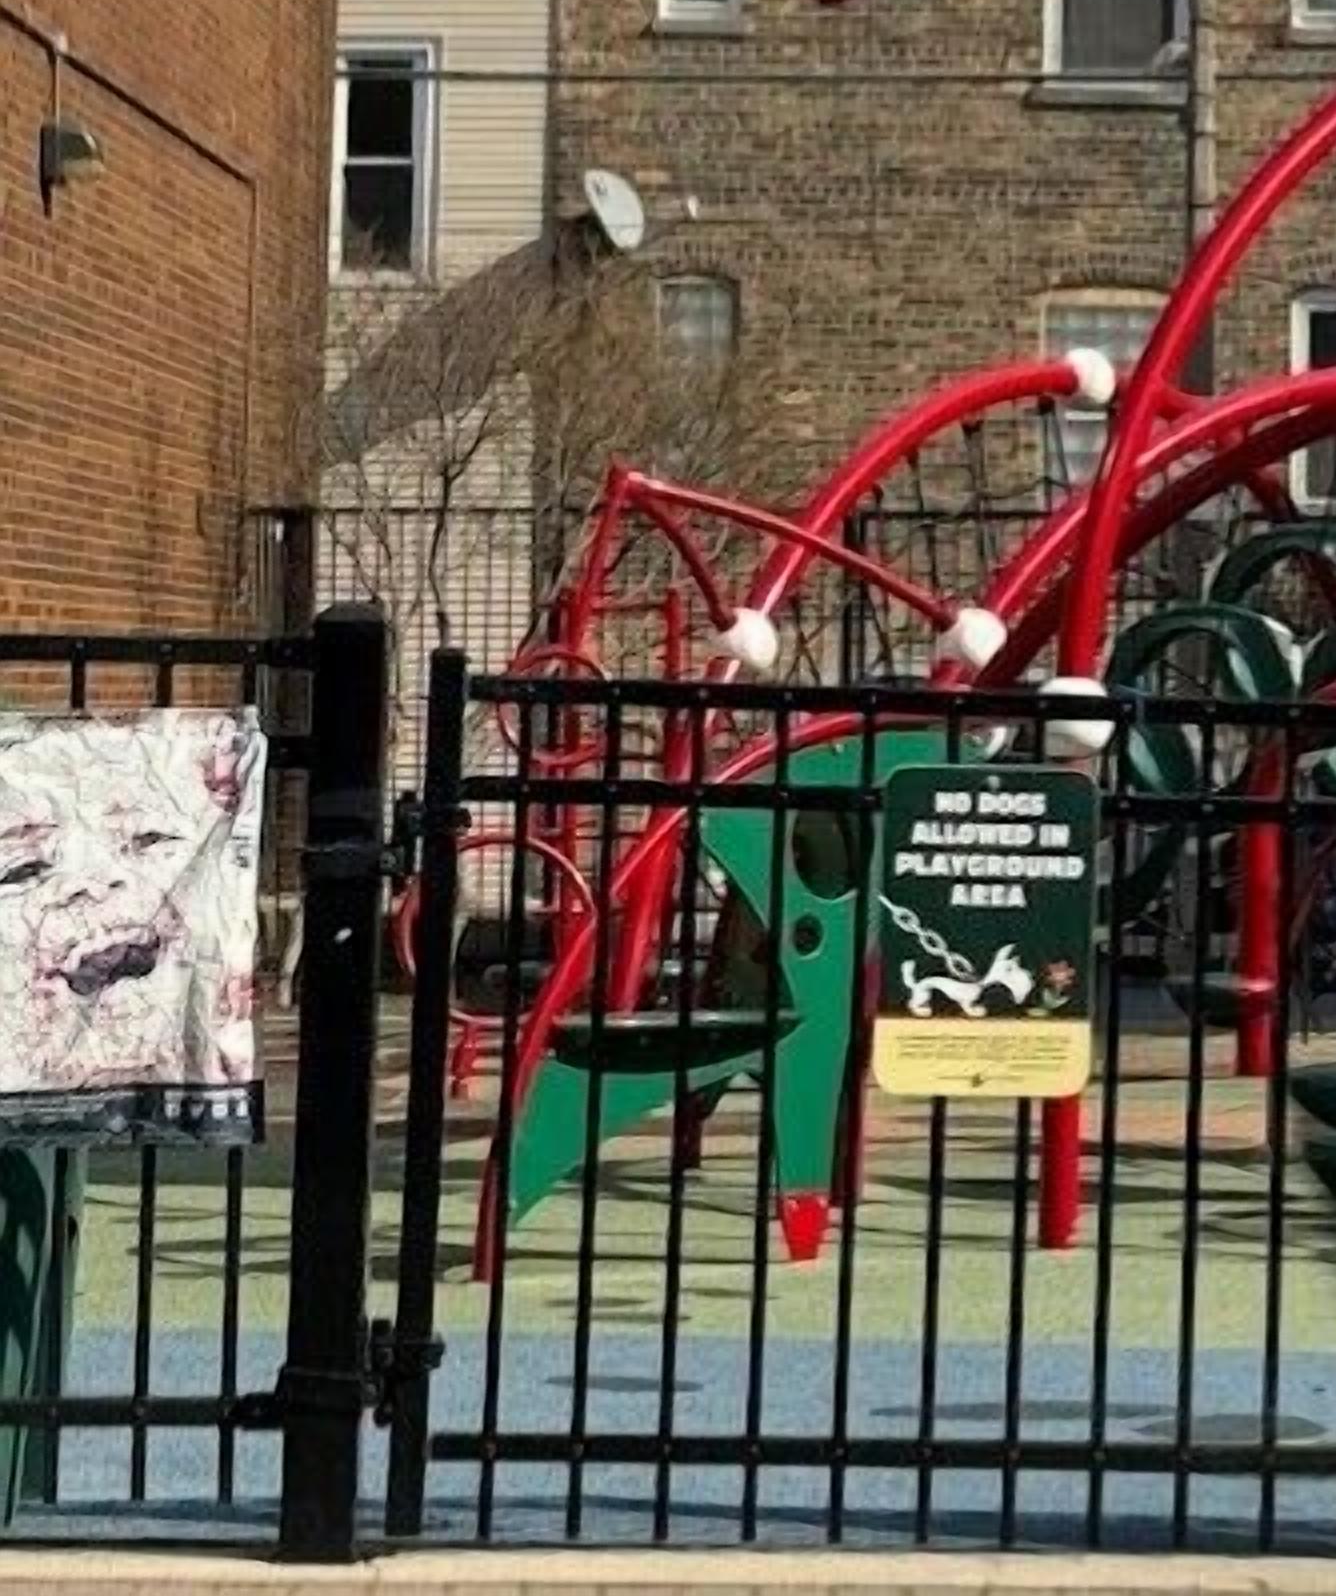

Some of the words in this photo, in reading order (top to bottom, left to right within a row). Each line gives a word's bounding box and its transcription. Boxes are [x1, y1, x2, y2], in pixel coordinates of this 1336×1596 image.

[935, 792, 972, 814] NO
[977, 792, 1047, 817] DOGS
[911, 821, 1033, 845] ALLOWED
[1039, 823, 1070, 847] IN
[894, 852, 1085, 879] PLAYGROUND
[951, 883, 1027, 907] AREA
